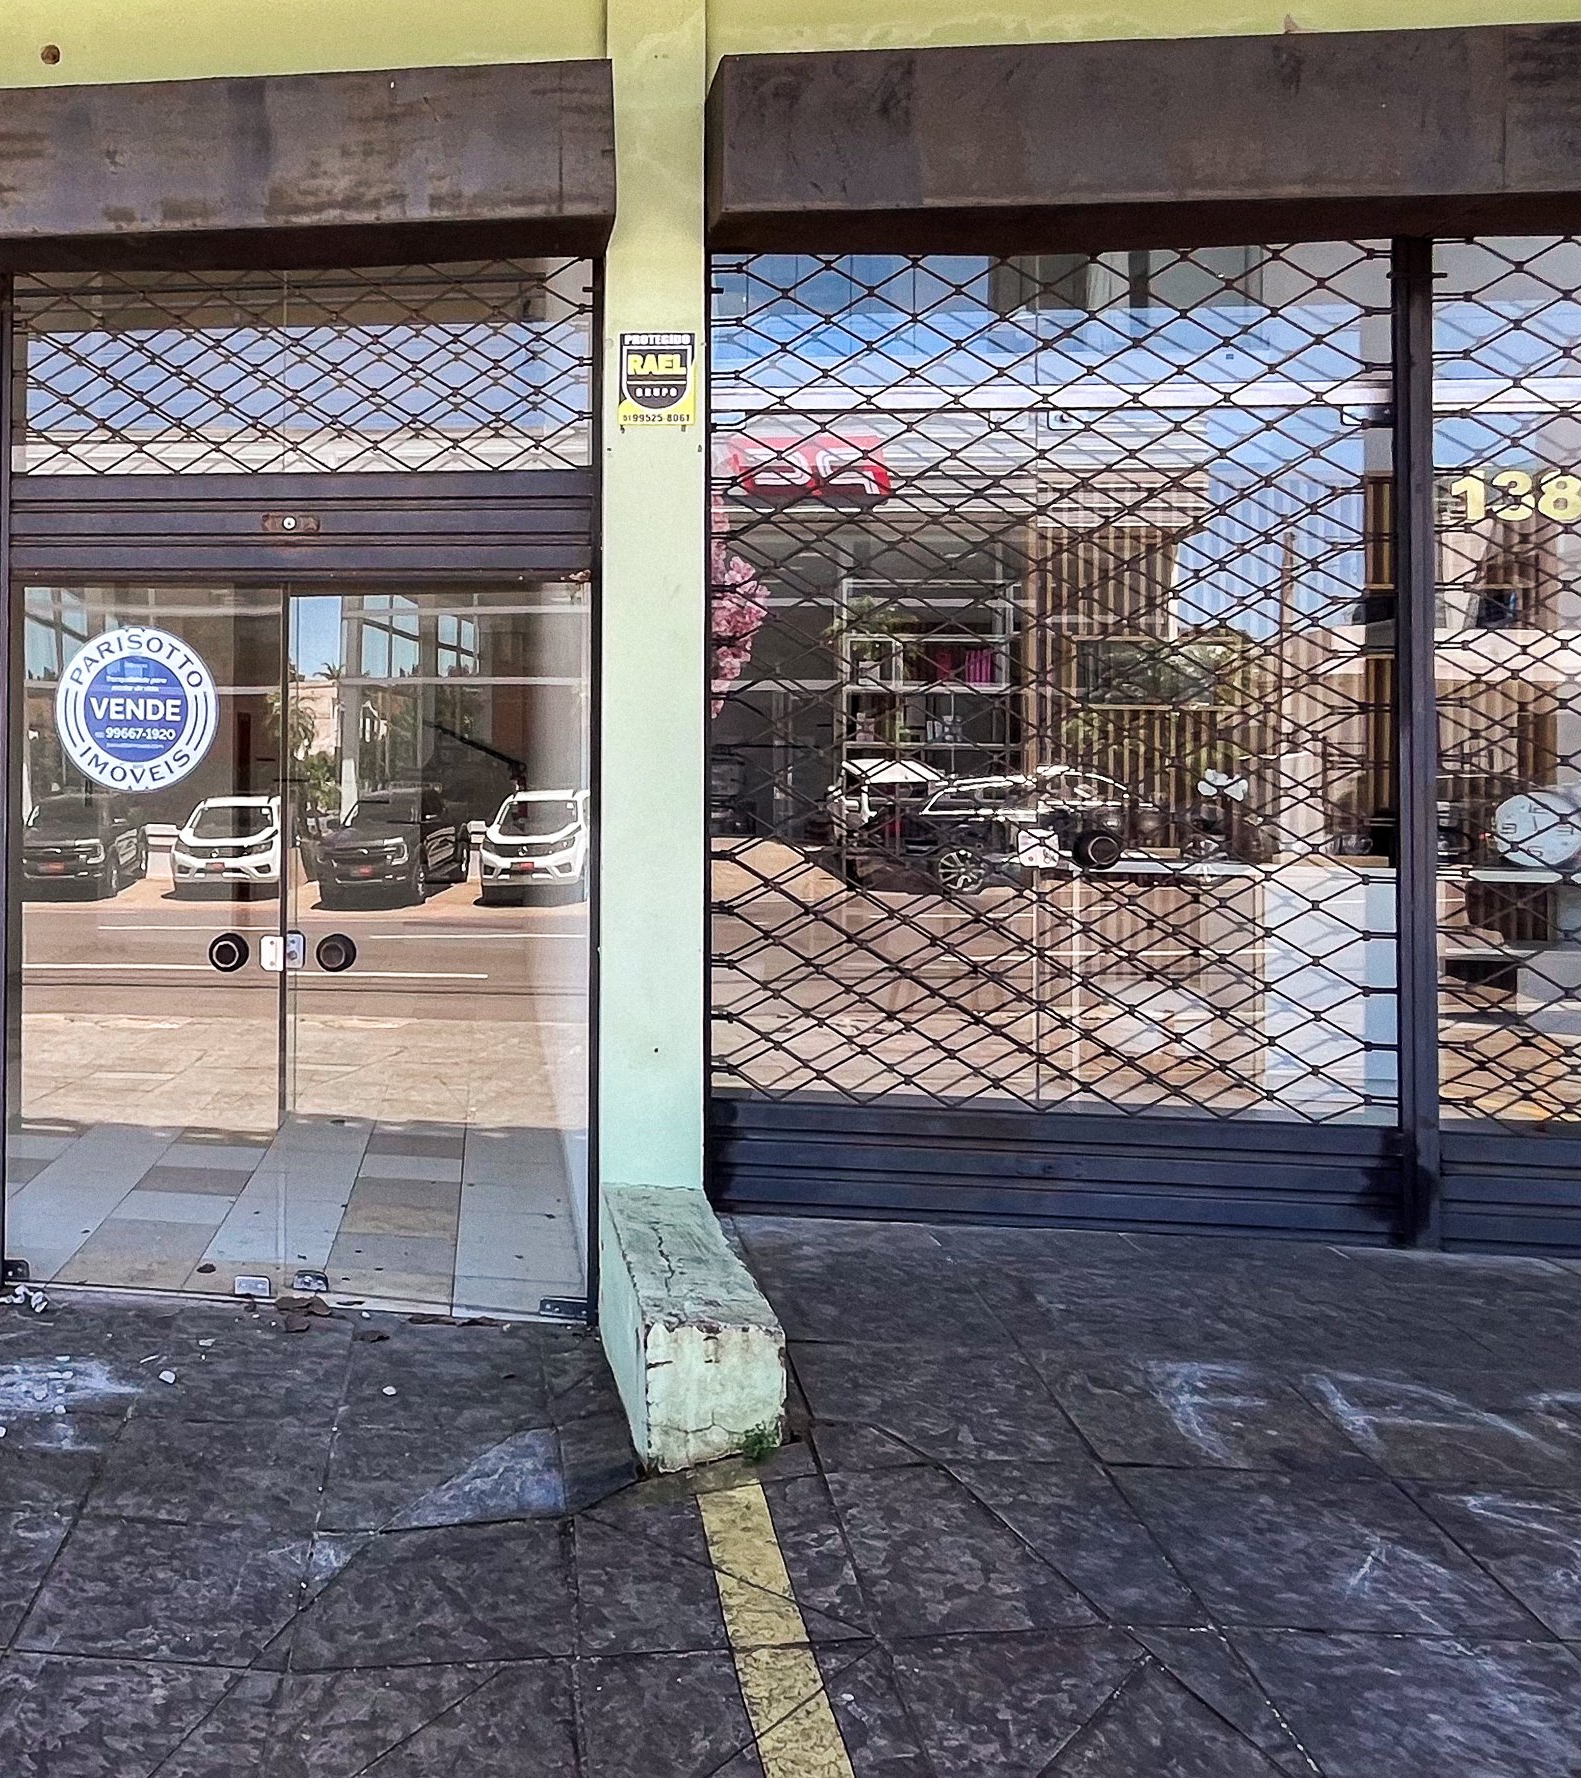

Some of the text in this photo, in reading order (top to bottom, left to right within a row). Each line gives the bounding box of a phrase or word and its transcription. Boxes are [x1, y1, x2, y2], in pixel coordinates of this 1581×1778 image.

[627, 353, 687, 375] RAEL
[70, 634, 203, 688] PARISOTTO
[89, 697, 182, 721] VENDE
[105, 726, 176, 741] 99667-1920
